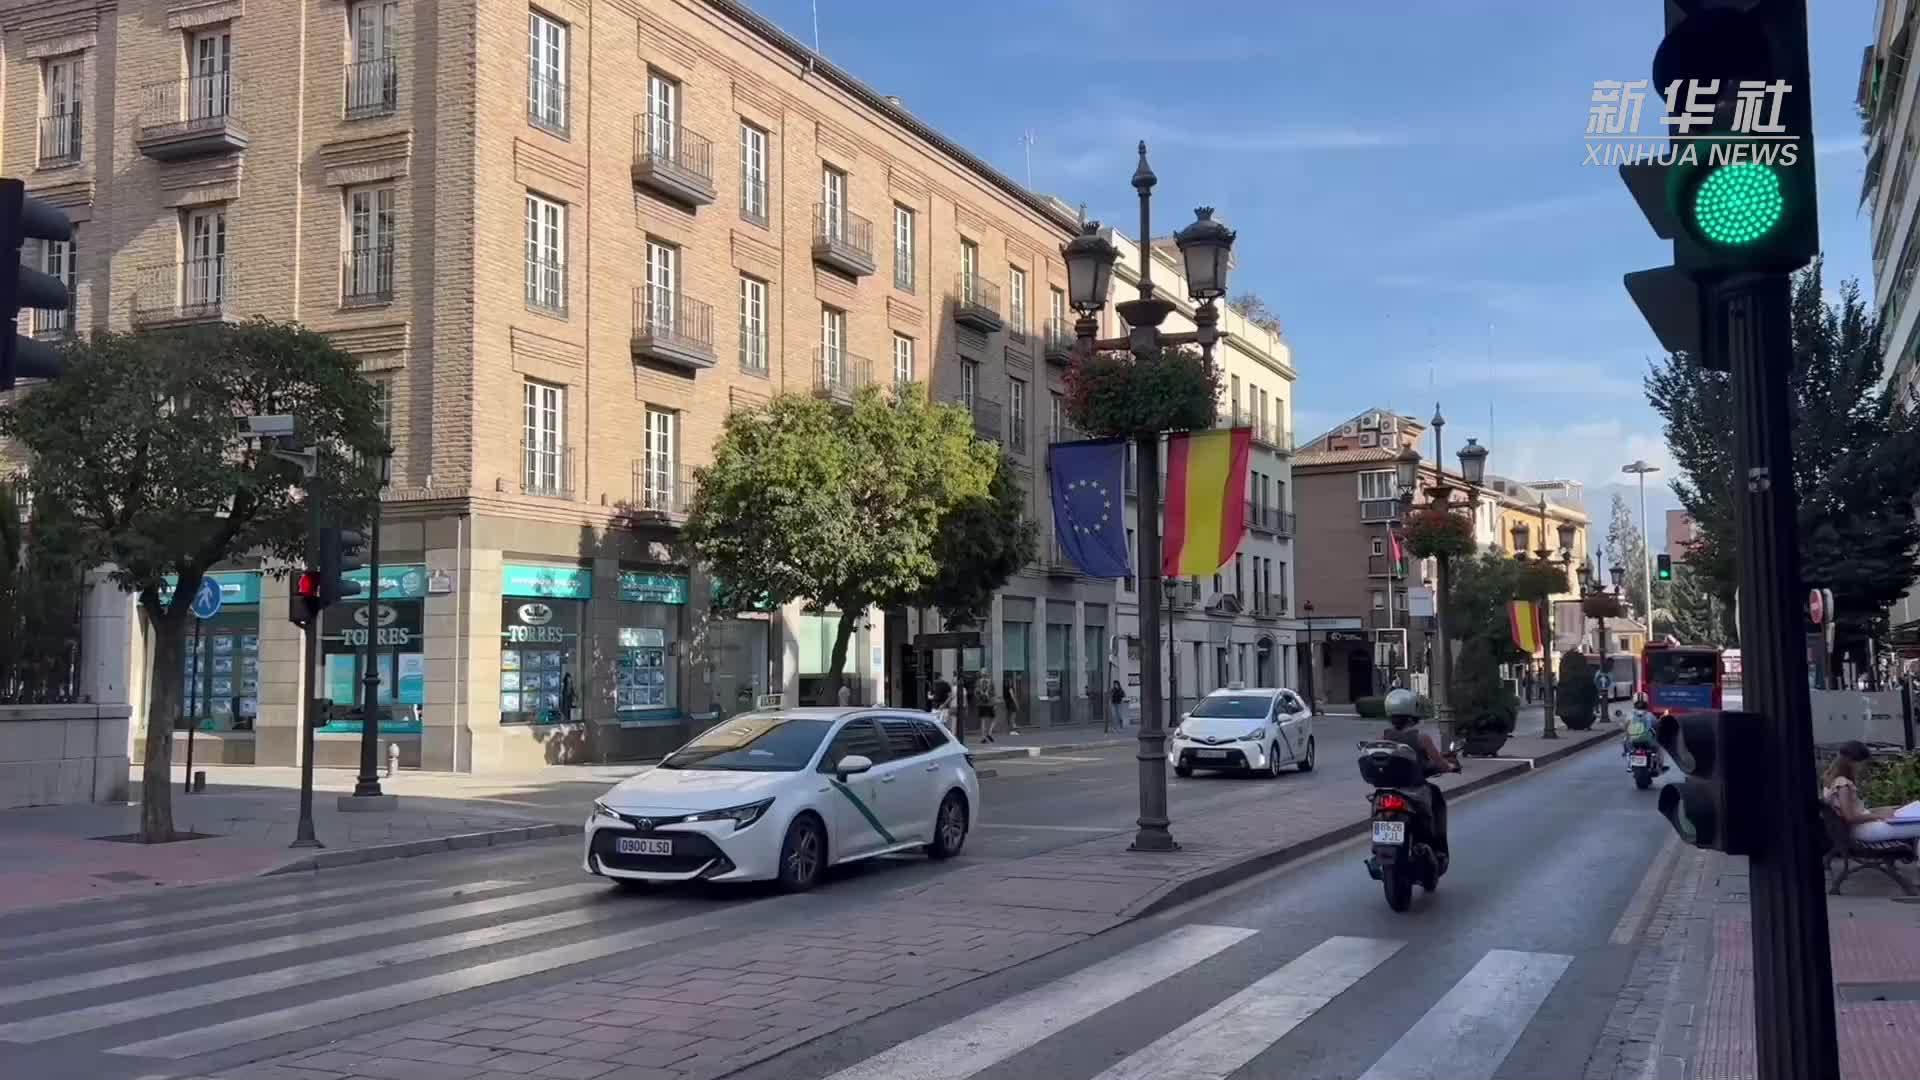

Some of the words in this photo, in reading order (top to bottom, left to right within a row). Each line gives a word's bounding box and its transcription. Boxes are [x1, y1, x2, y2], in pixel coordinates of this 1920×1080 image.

[342, 628, 409, 645] TORES
[508, 624, 563, 643] TORRES
[622, 840, 647, 852] 0900
[649, 842, 670, 854] LSD
